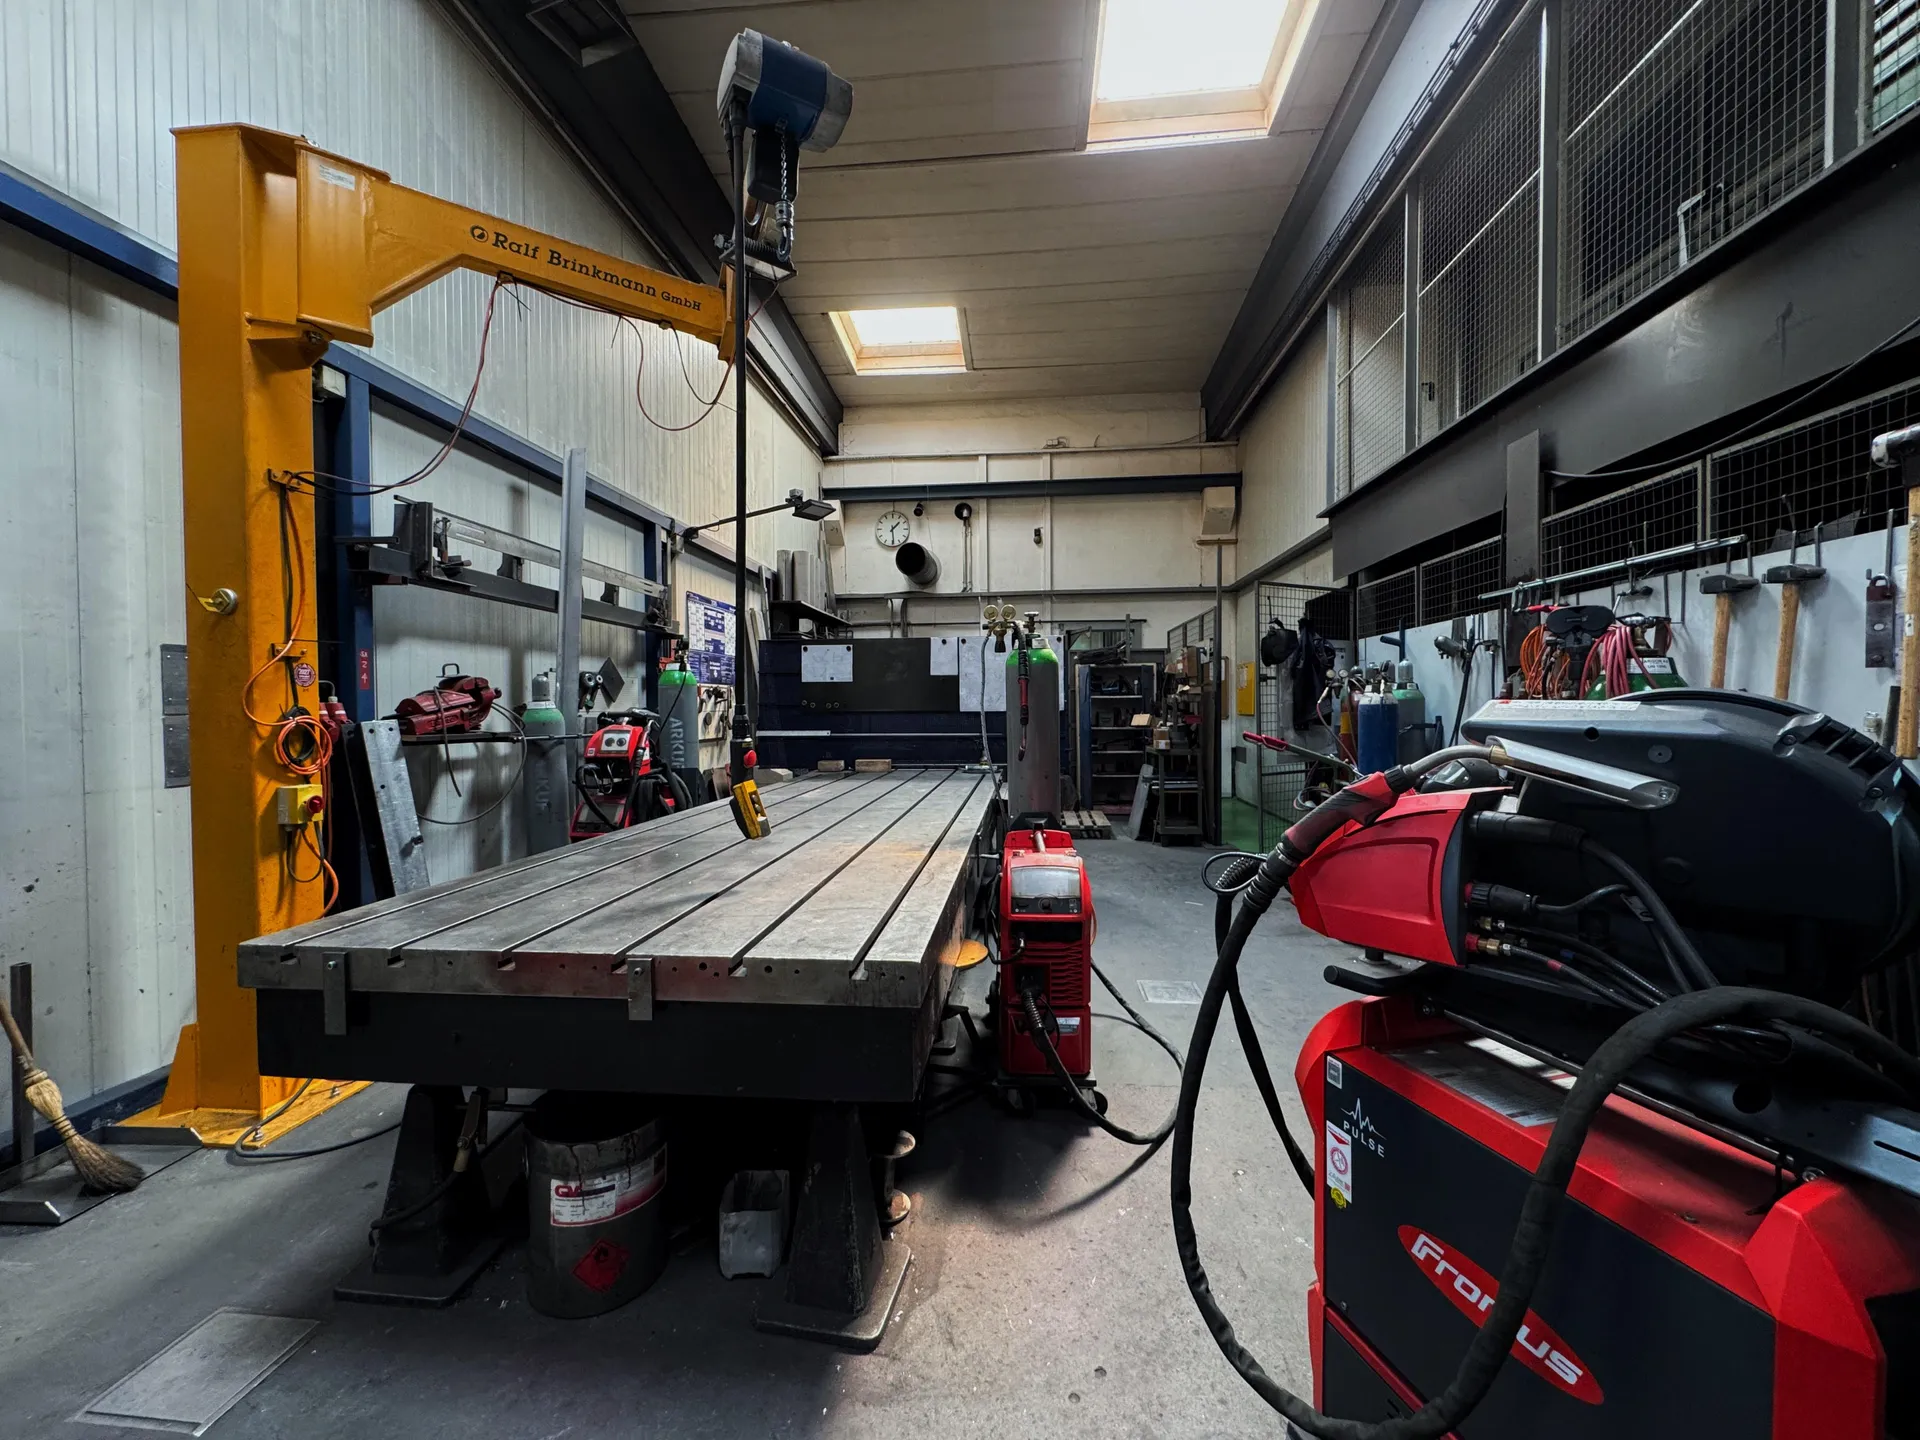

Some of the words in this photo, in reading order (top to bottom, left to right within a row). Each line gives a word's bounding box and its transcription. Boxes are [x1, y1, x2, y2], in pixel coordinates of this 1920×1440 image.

[492, 231, 539, 259] Ralf
[547, 249, 657, 297] Brinkmann
[661, 291, 702, 312] GmbH
[1343, 1120, 1385, 1158] PULSE
[1411, 1233, 1583, 1385] Frous
